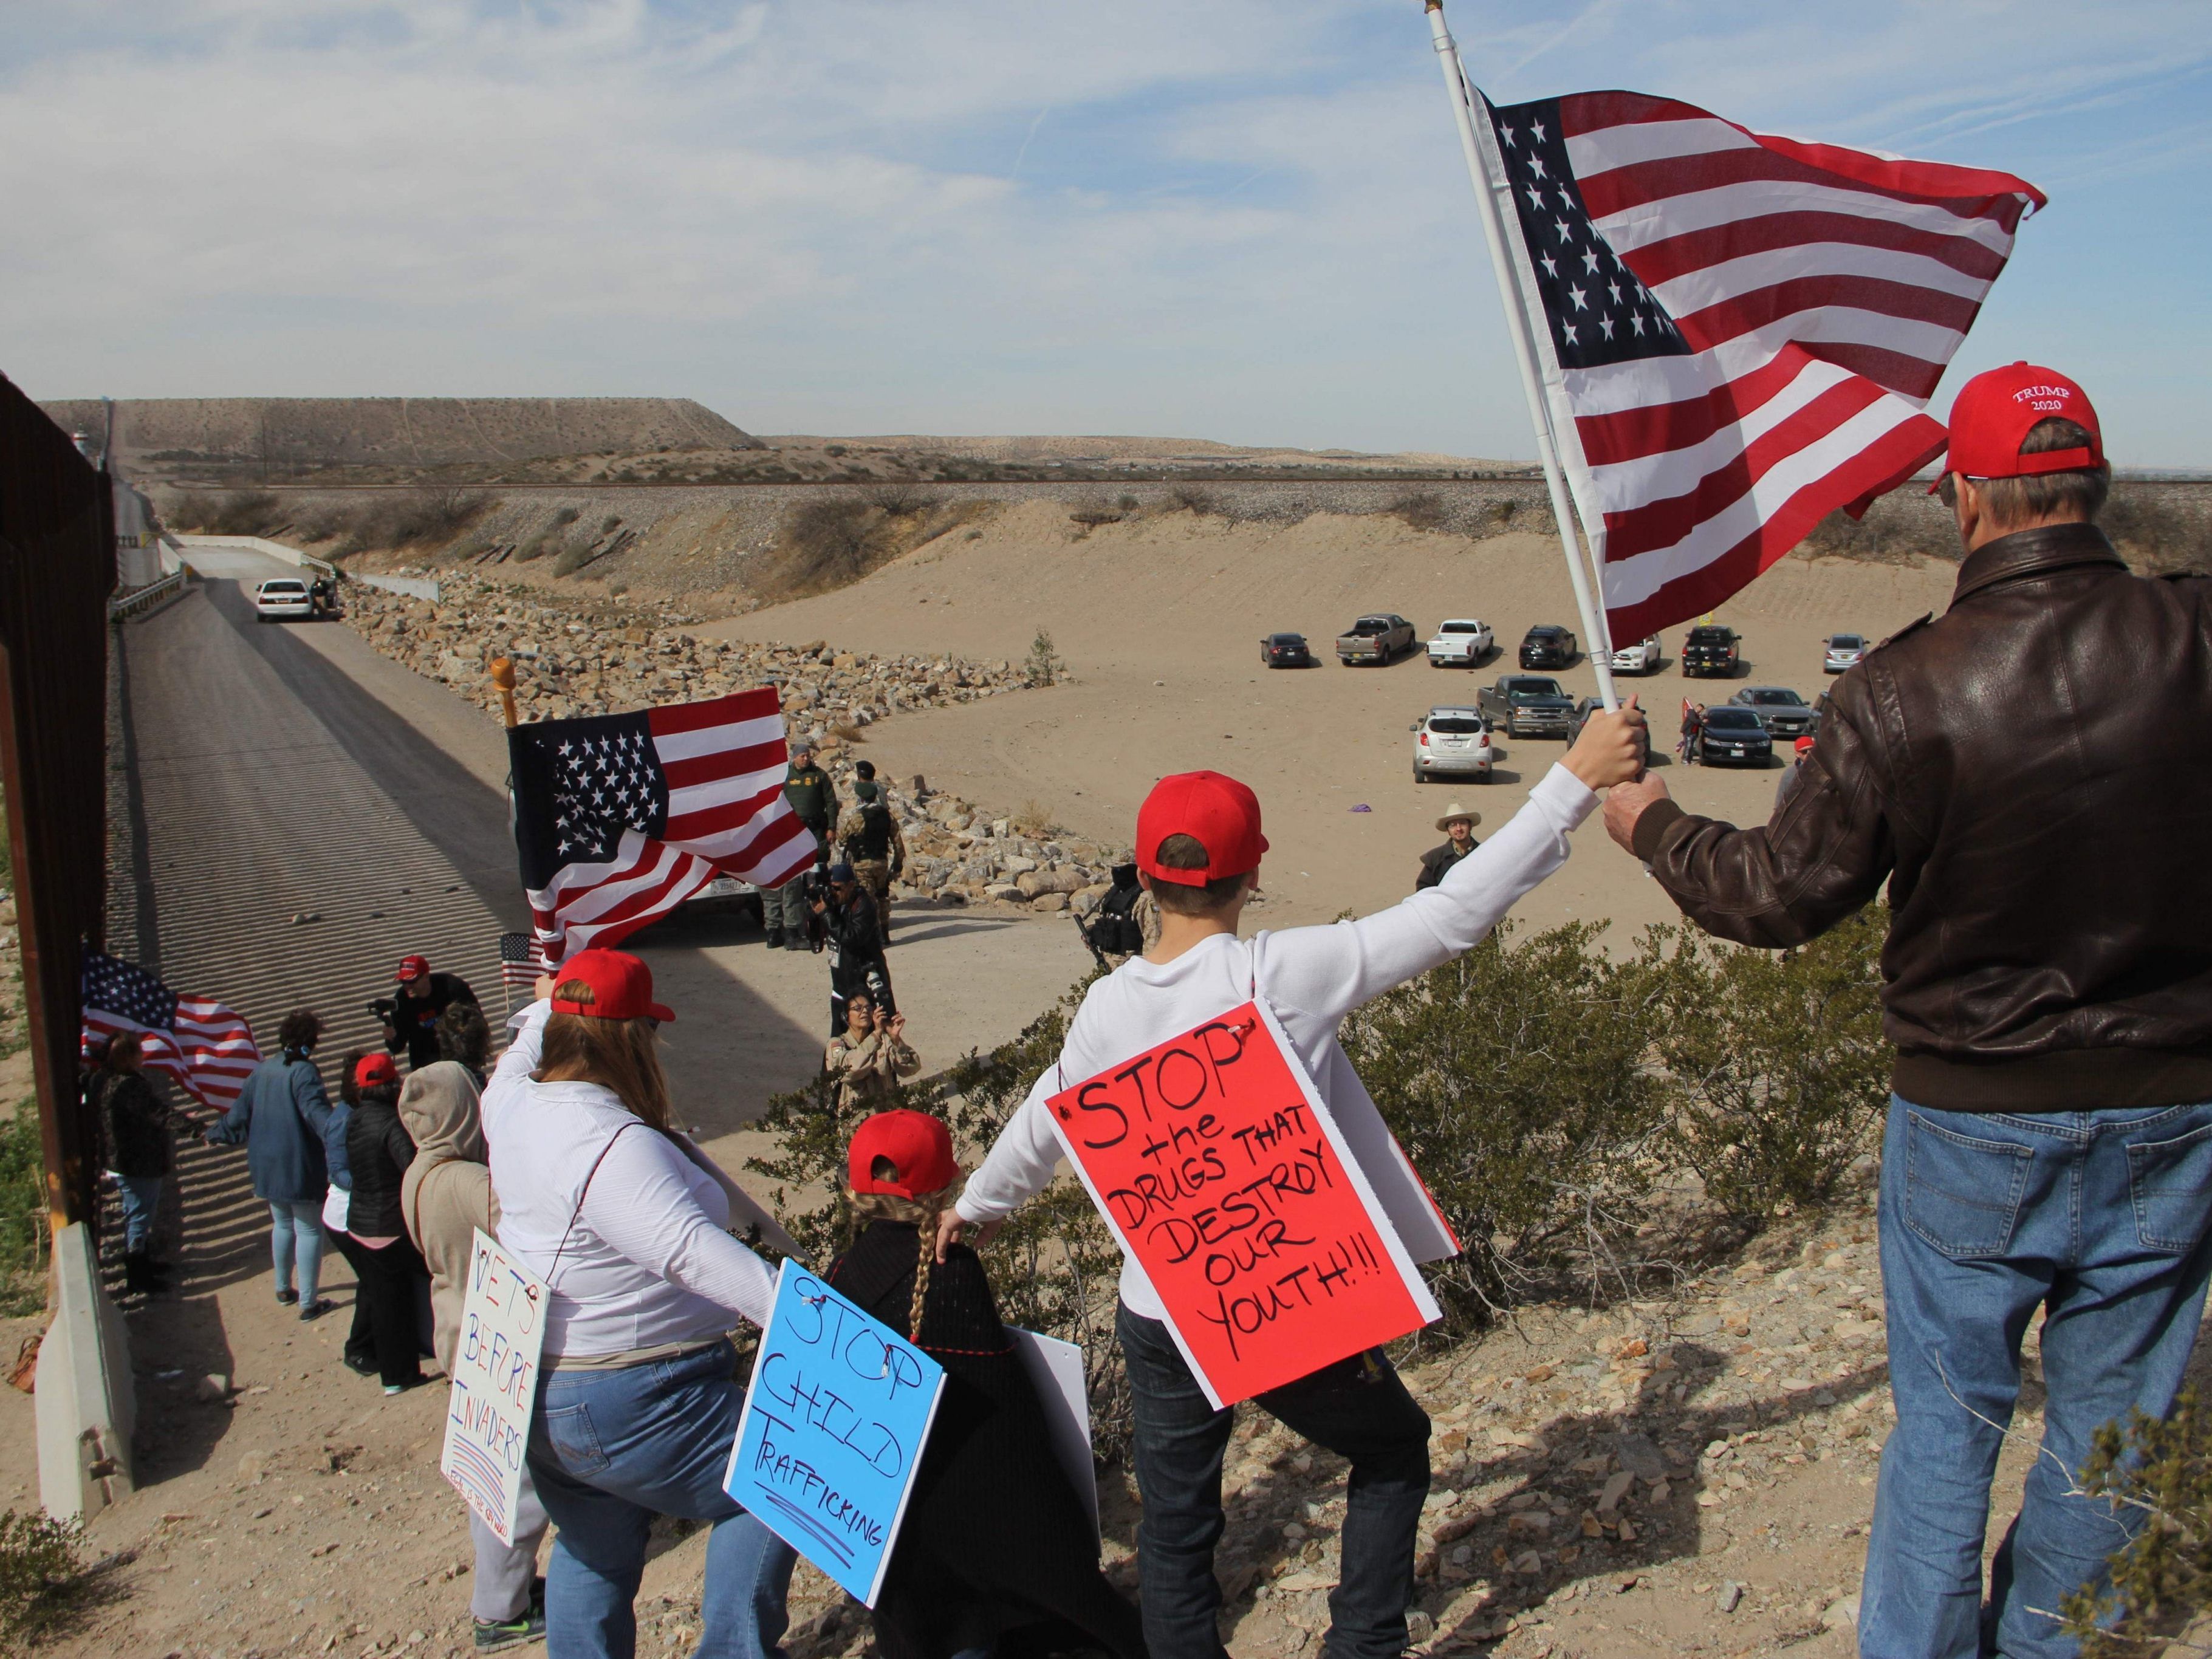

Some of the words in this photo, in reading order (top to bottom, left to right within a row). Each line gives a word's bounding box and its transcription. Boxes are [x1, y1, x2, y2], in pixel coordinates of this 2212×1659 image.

[2012, 385, 2070, 403] TRUMP
[2031, 400, 2061, 410] 2020
[1077, 1021, 1243, 1149] STOP
[1106, 1147, 1227, 1230] DRUGS
[1231, 1104, 1305, 1166] THAT
[1141, 1113, 1225, 1165] the
[1146, 1138, 1333, 1264] DESTROY
[476, 1240, 540, 1335] VETS
[1197, 1232, 1380, 1361] YOUTH!!!
[1204, 1219, 1317, 1286] OUR
[464, 1312, 533, 1412] BEFORE
[785, 1276, 922, 1400] STOP
[451, 1379, 523, 1471] INVADERS
[761, 1352, 902, 1478] CHILD
[466, 1488, 473, 1499] IS
[474, 1493, 484, 1512] THE
[752, 1404, 882, 1547] TRAFFICKING
